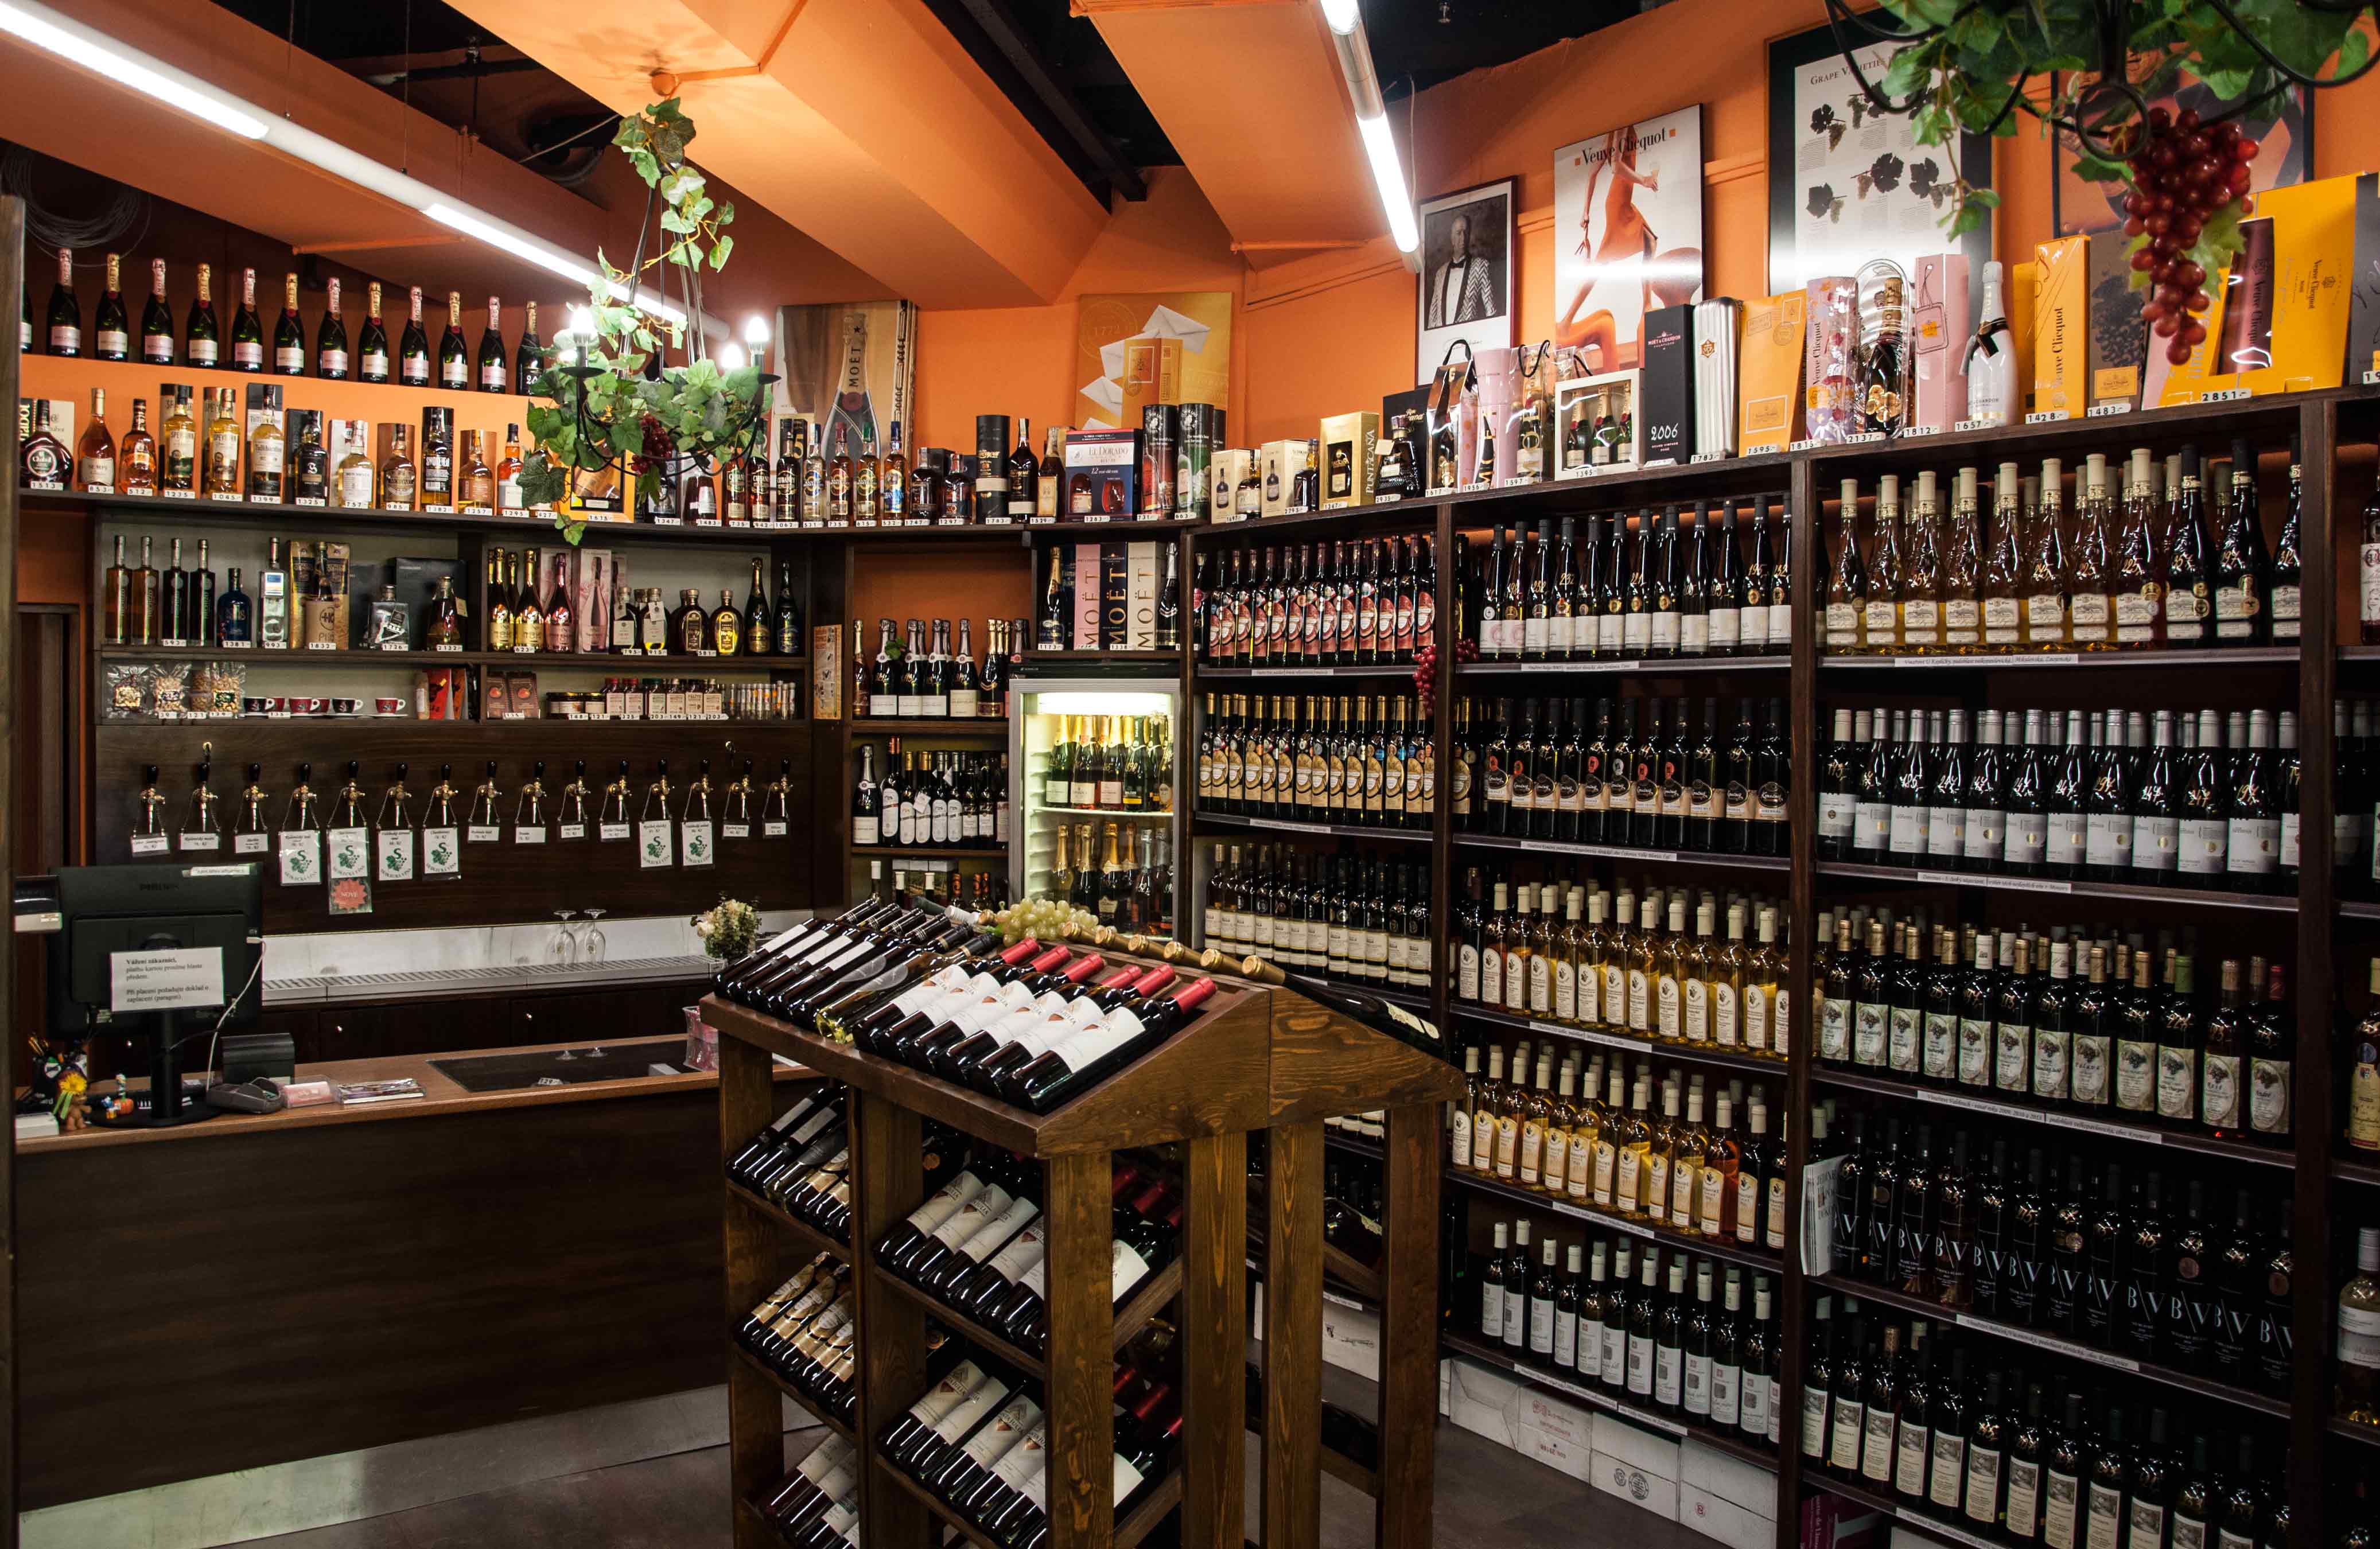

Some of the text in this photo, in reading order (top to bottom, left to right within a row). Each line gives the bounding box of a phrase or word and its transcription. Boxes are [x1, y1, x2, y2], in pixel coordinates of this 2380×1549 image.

[1810, 72, 1840, 86] GRAPE
[1582, 130, 1666, 165] Veuve Clicquot
[2051, 308, 2065, 352] Clicquot
[849, 347, 861, 387] MOËT
[1650, 423, 1679, 441] 2006
[1084, 571, 1100, 644] MOËT
[1106, 567, 1126, 644] MOËT
[1135, 569, 1154, 649] MOËT
